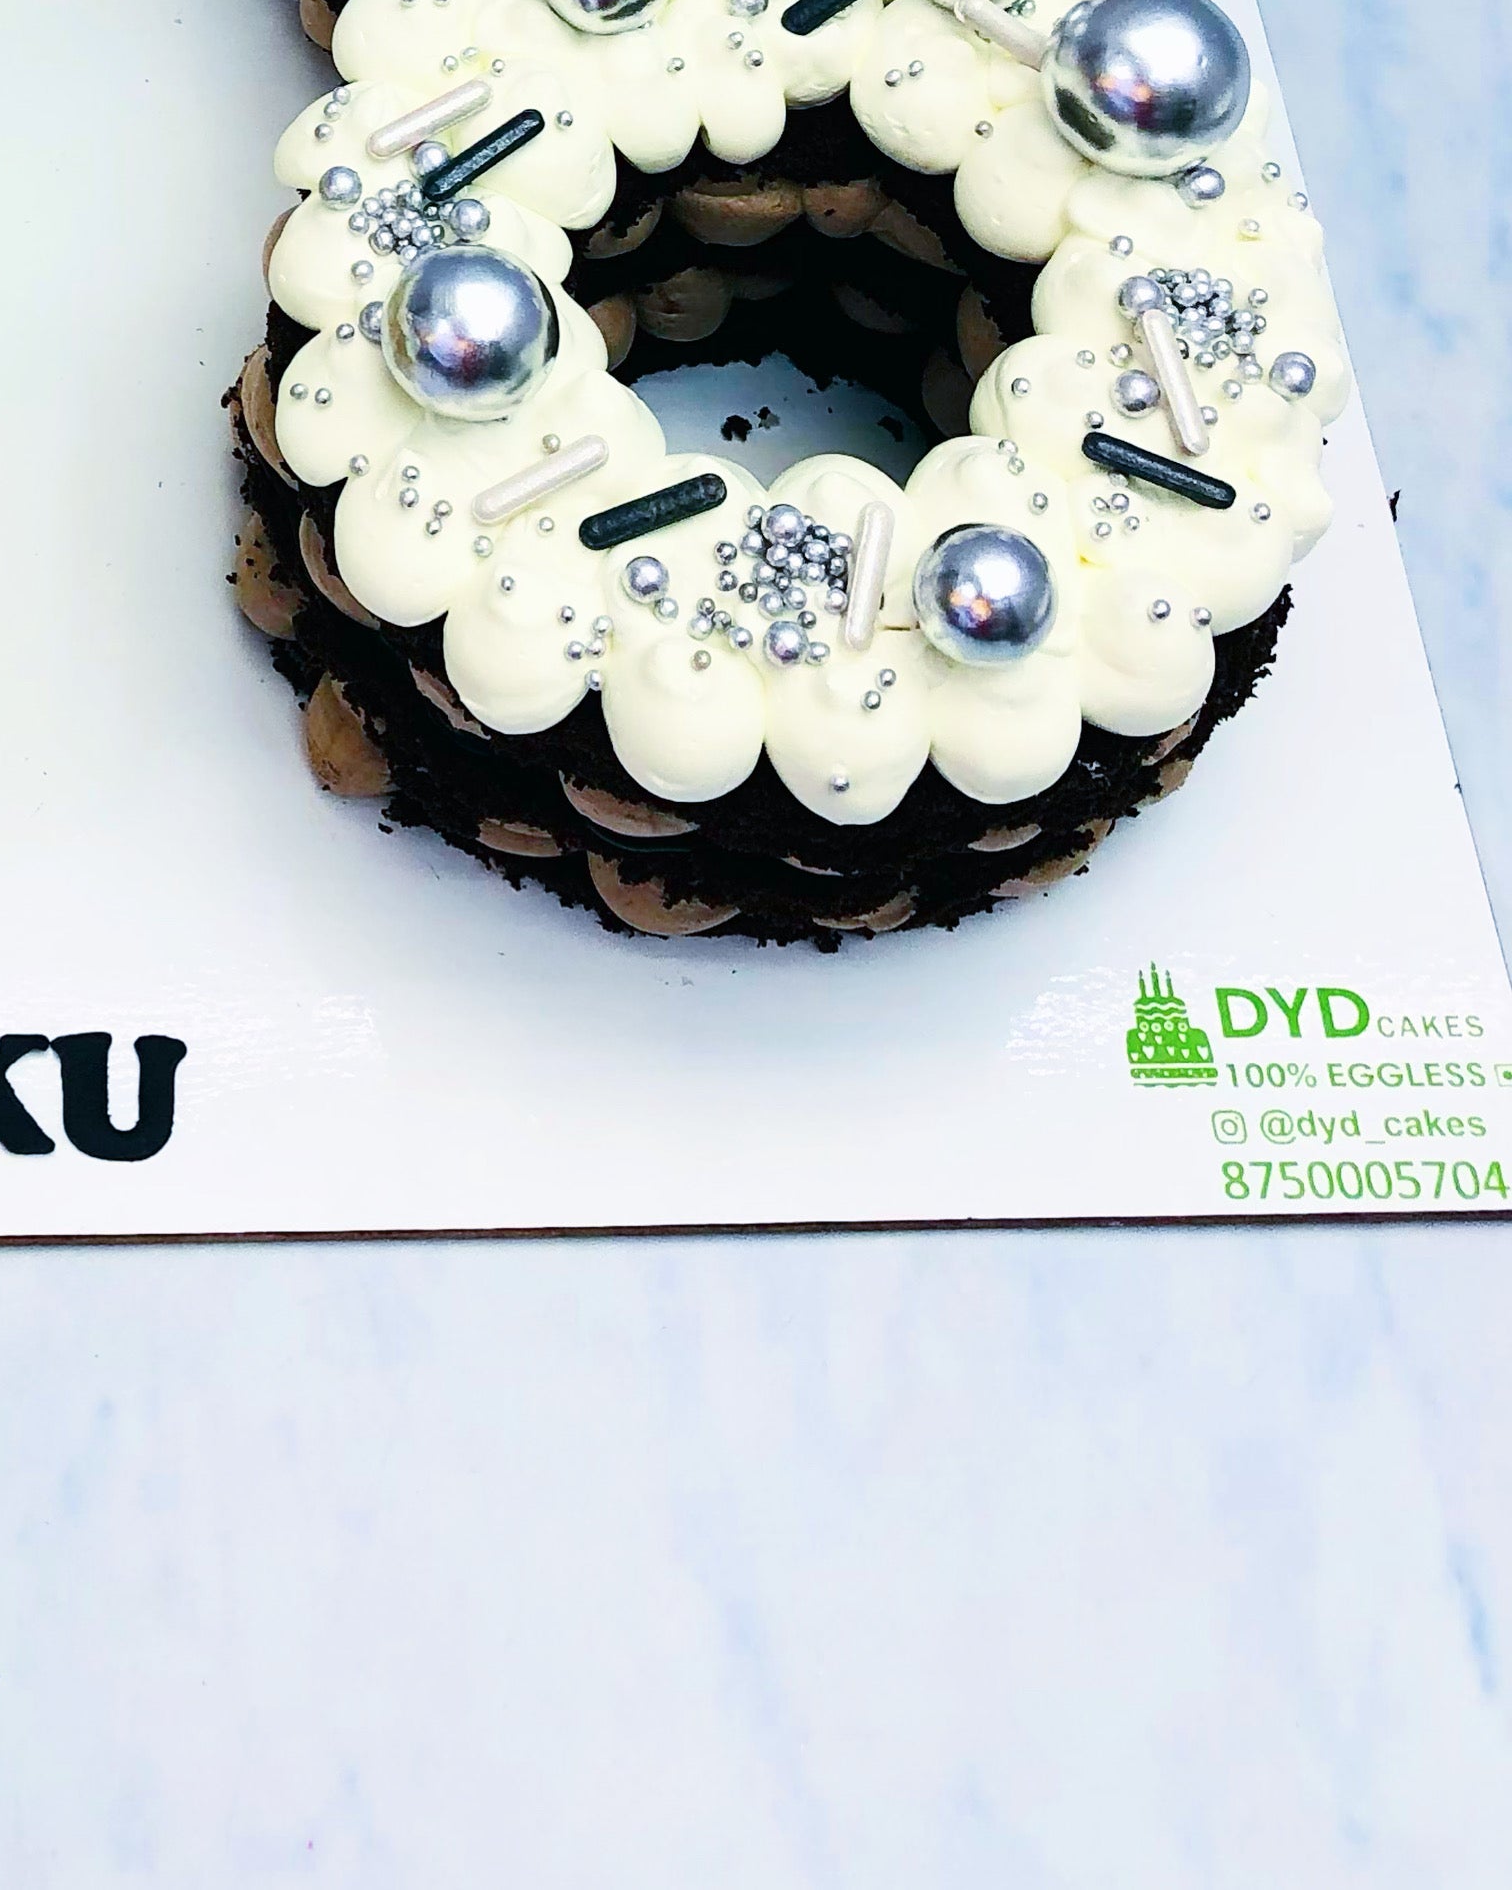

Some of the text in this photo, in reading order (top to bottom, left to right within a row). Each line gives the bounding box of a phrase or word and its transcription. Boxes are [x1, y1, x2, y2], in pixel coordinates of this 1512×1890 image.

[1214, 987, 1485, 1039] DYD CAKES
[1225, 1062, 1487, 1089] 100% EGGLESS
[1259, 1109, 1488, 1145] @dyd_cakes
[1221, 1160, 1511, 1200] 8750005704
